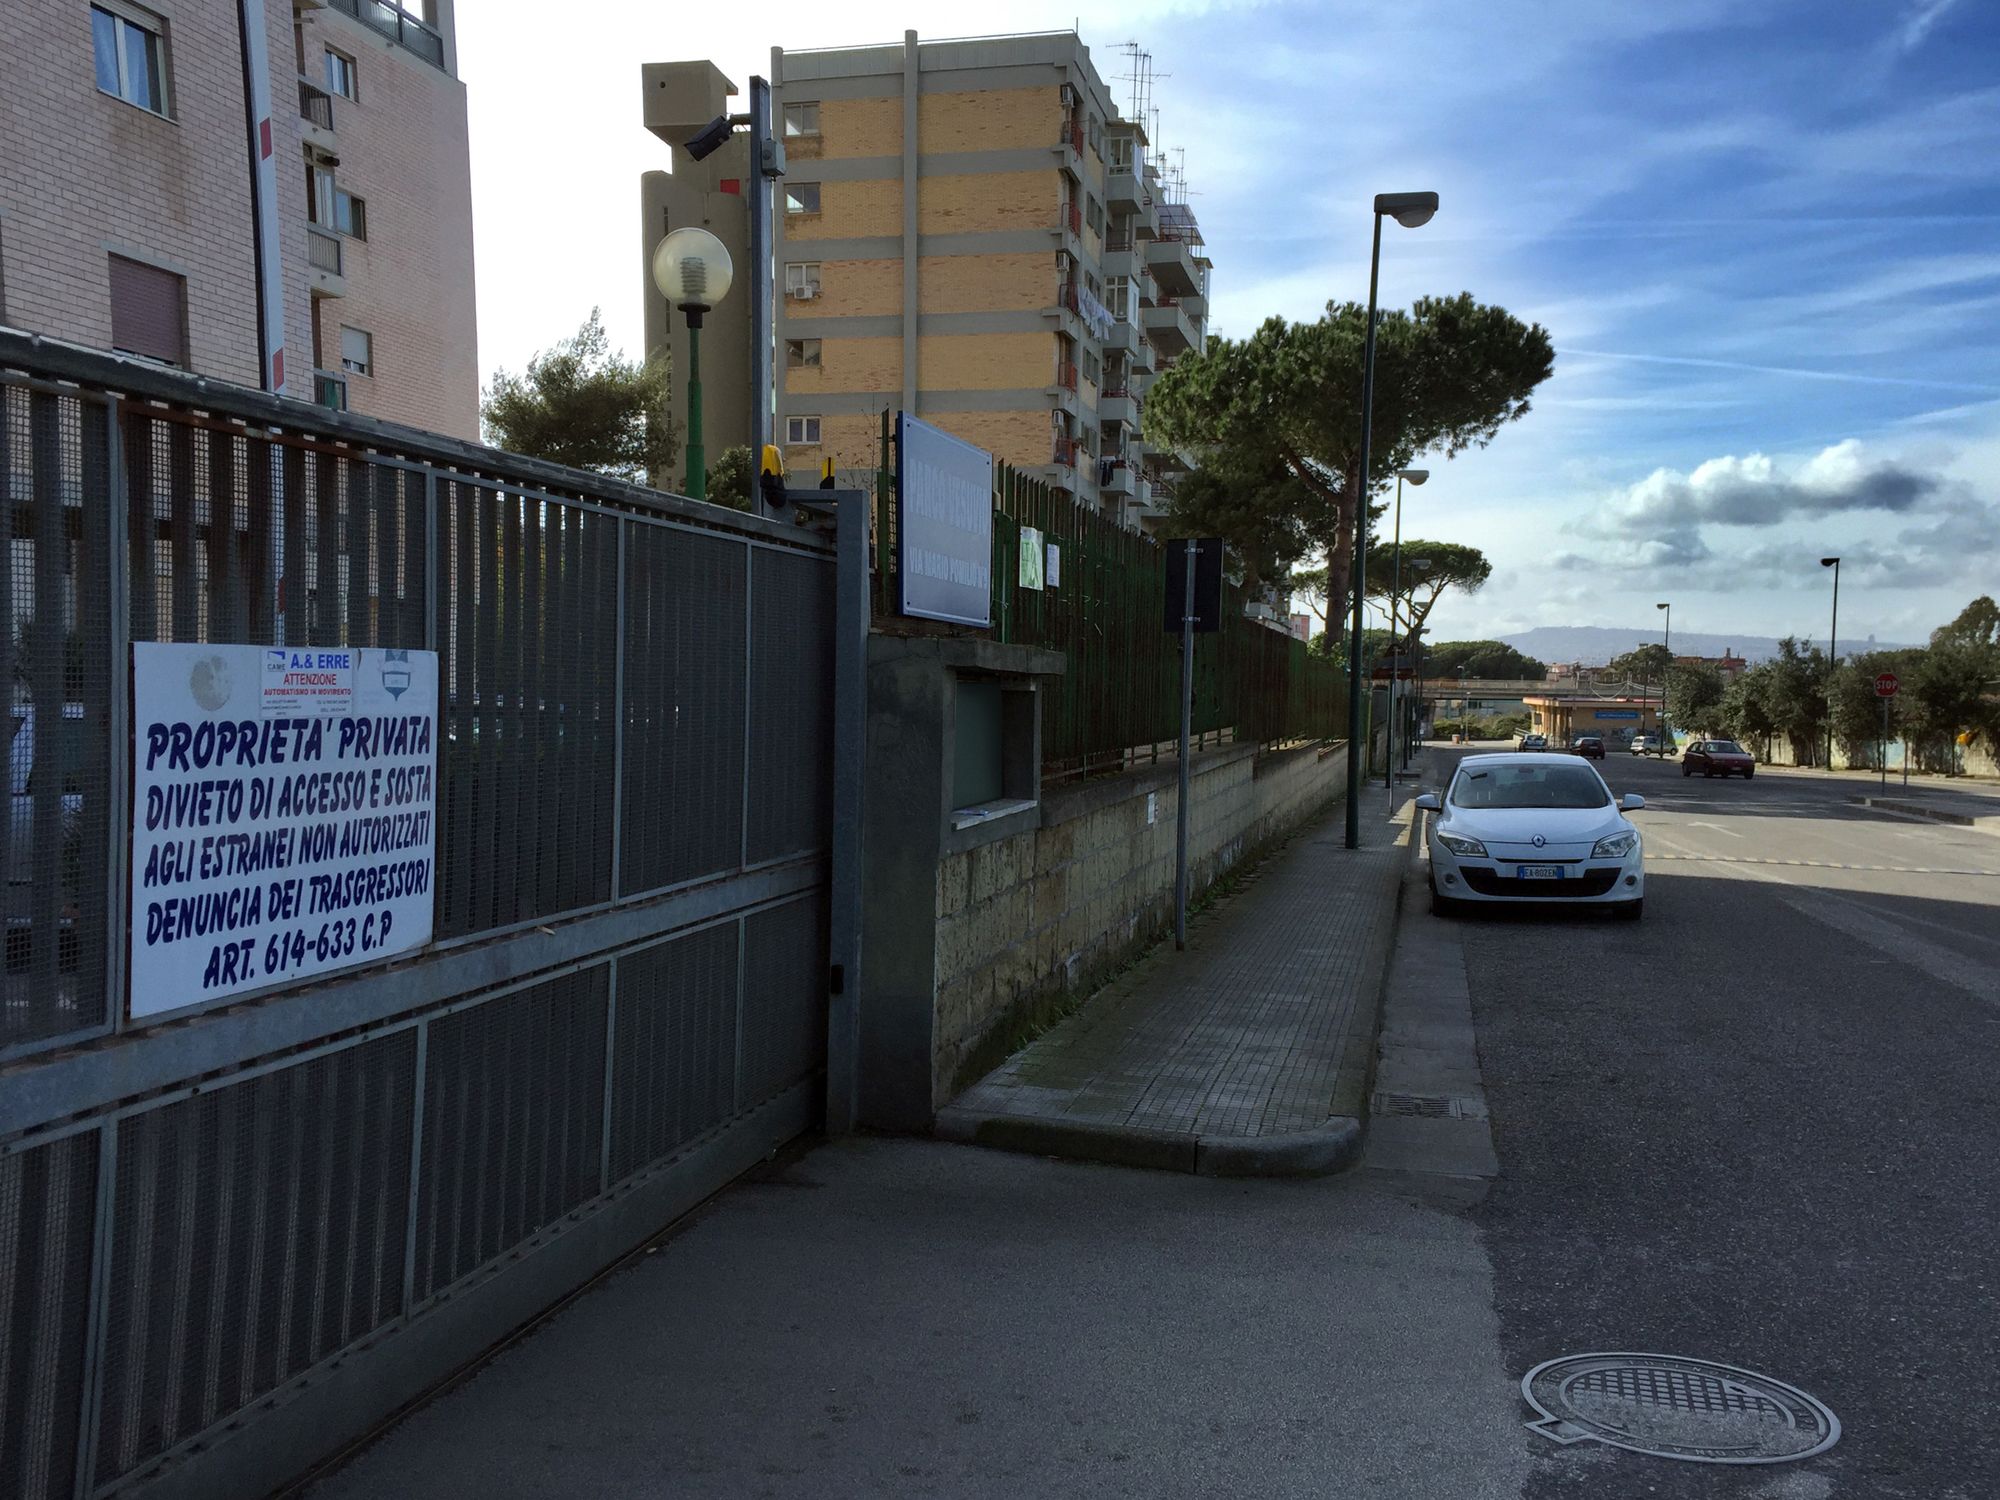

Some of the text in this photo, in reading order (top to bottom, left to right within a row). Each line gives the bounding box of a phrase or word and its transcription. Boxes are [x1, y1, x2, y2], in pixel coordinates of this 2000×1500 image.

[909, 545, 924, 576] VIA
[925, 549, 949, 581] MARIO
[267, 663, 286, 671] CAME
[283, 673, 337, 686] ATTENZIONE
[318, 654, 350, 669] ERRE
[263, 688, 352, 696] AUTOMATISMO IN MOVIMENTO
[1876, 680, 1898, 690] STOP
[146, 716, 431, 773] PROPRIETA' PRIVATA
[146, 765, 431, 832] DIVIETO DI ACCESSO E SOSTA
[143, 810, 431, 888] AGLI ESTRANEI NON AUTORIZZATI
[146, 858, 430, 946] DENUNCIA DEI TRASGRESSORI
[203, 910, 393, 989] ART. 614-633 C.P
